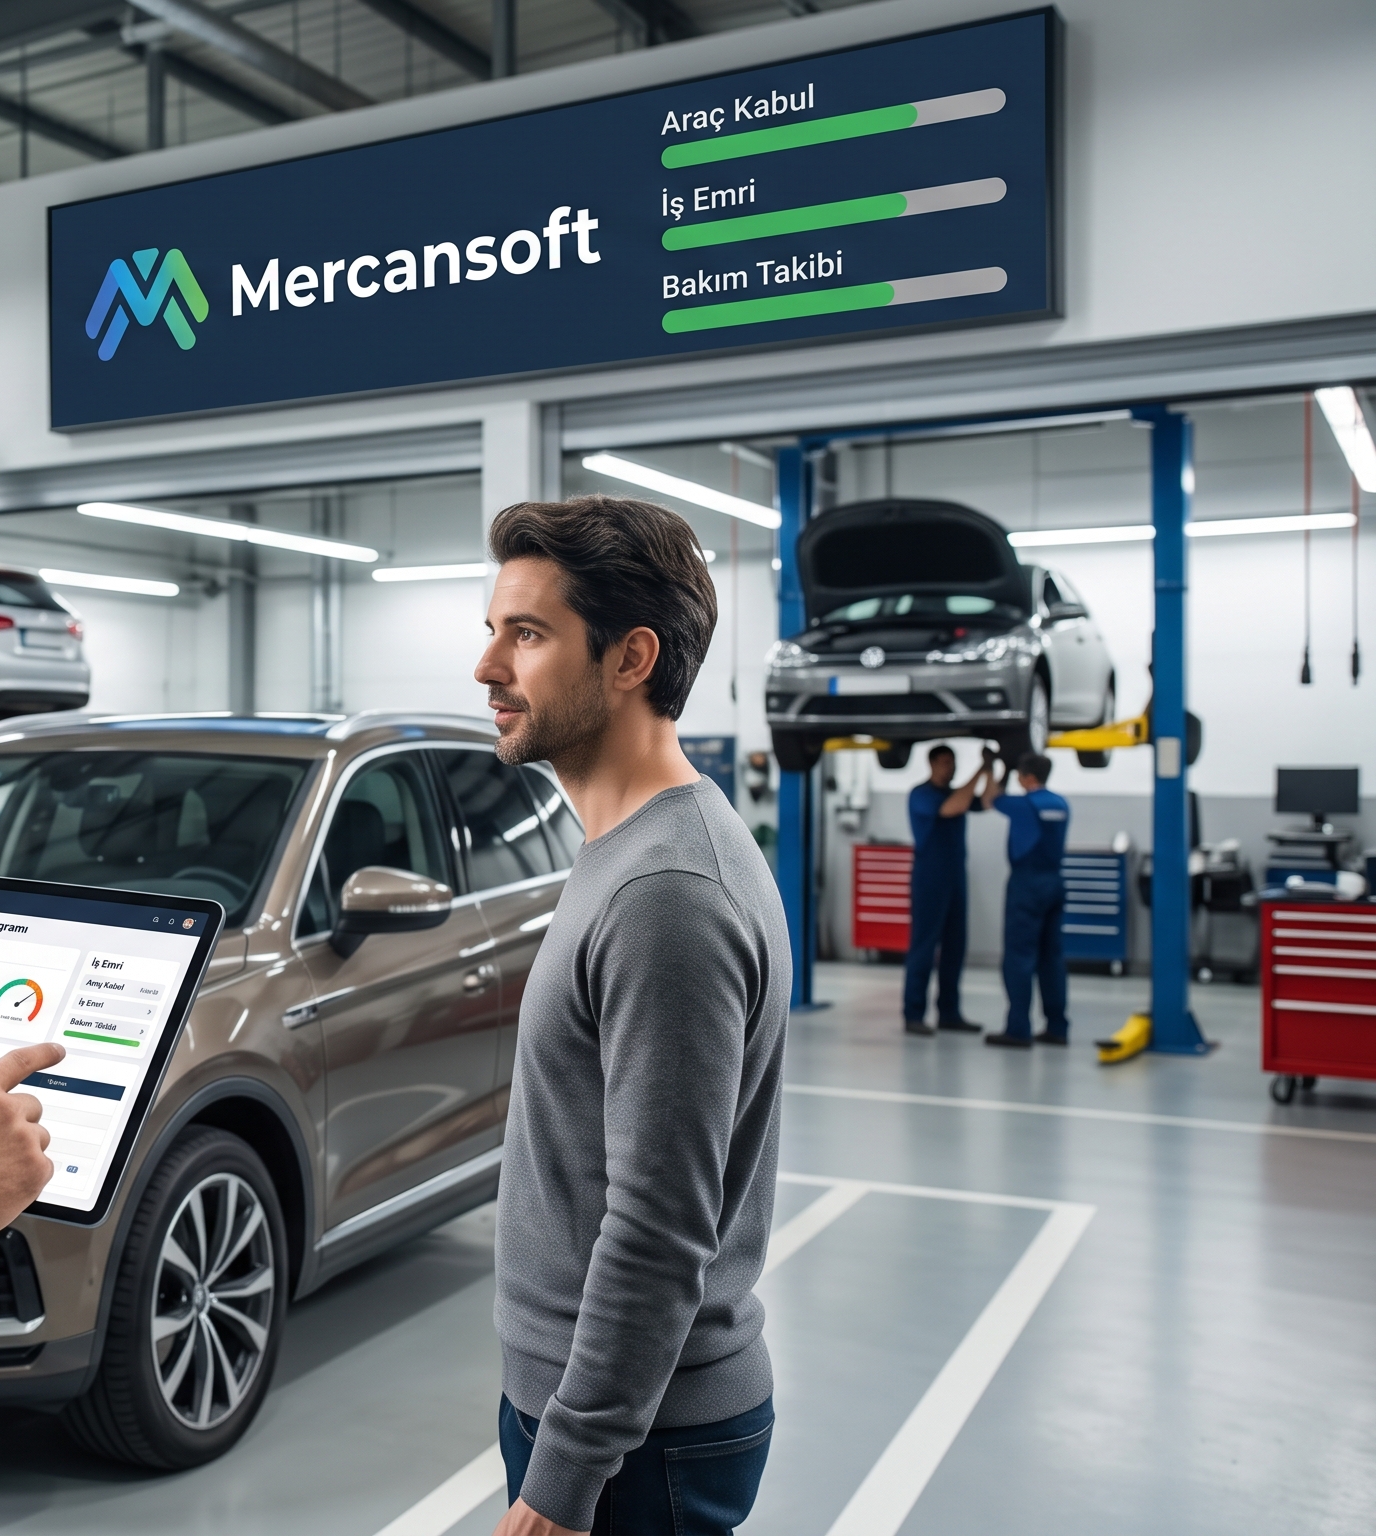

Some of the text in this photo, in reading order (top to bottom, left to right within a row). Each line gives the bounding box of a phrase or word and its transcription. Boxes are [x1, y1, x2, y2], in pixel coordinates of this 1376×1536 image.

[661, 83, 814, 136] Araç Kabul
[662, 178, 755, 221] İş Emri
[232, 206, 601, 317] Mercansoft
[662, 250, 843, 299] Bakım Takibi
[101, 960, 125, 970] Emri
